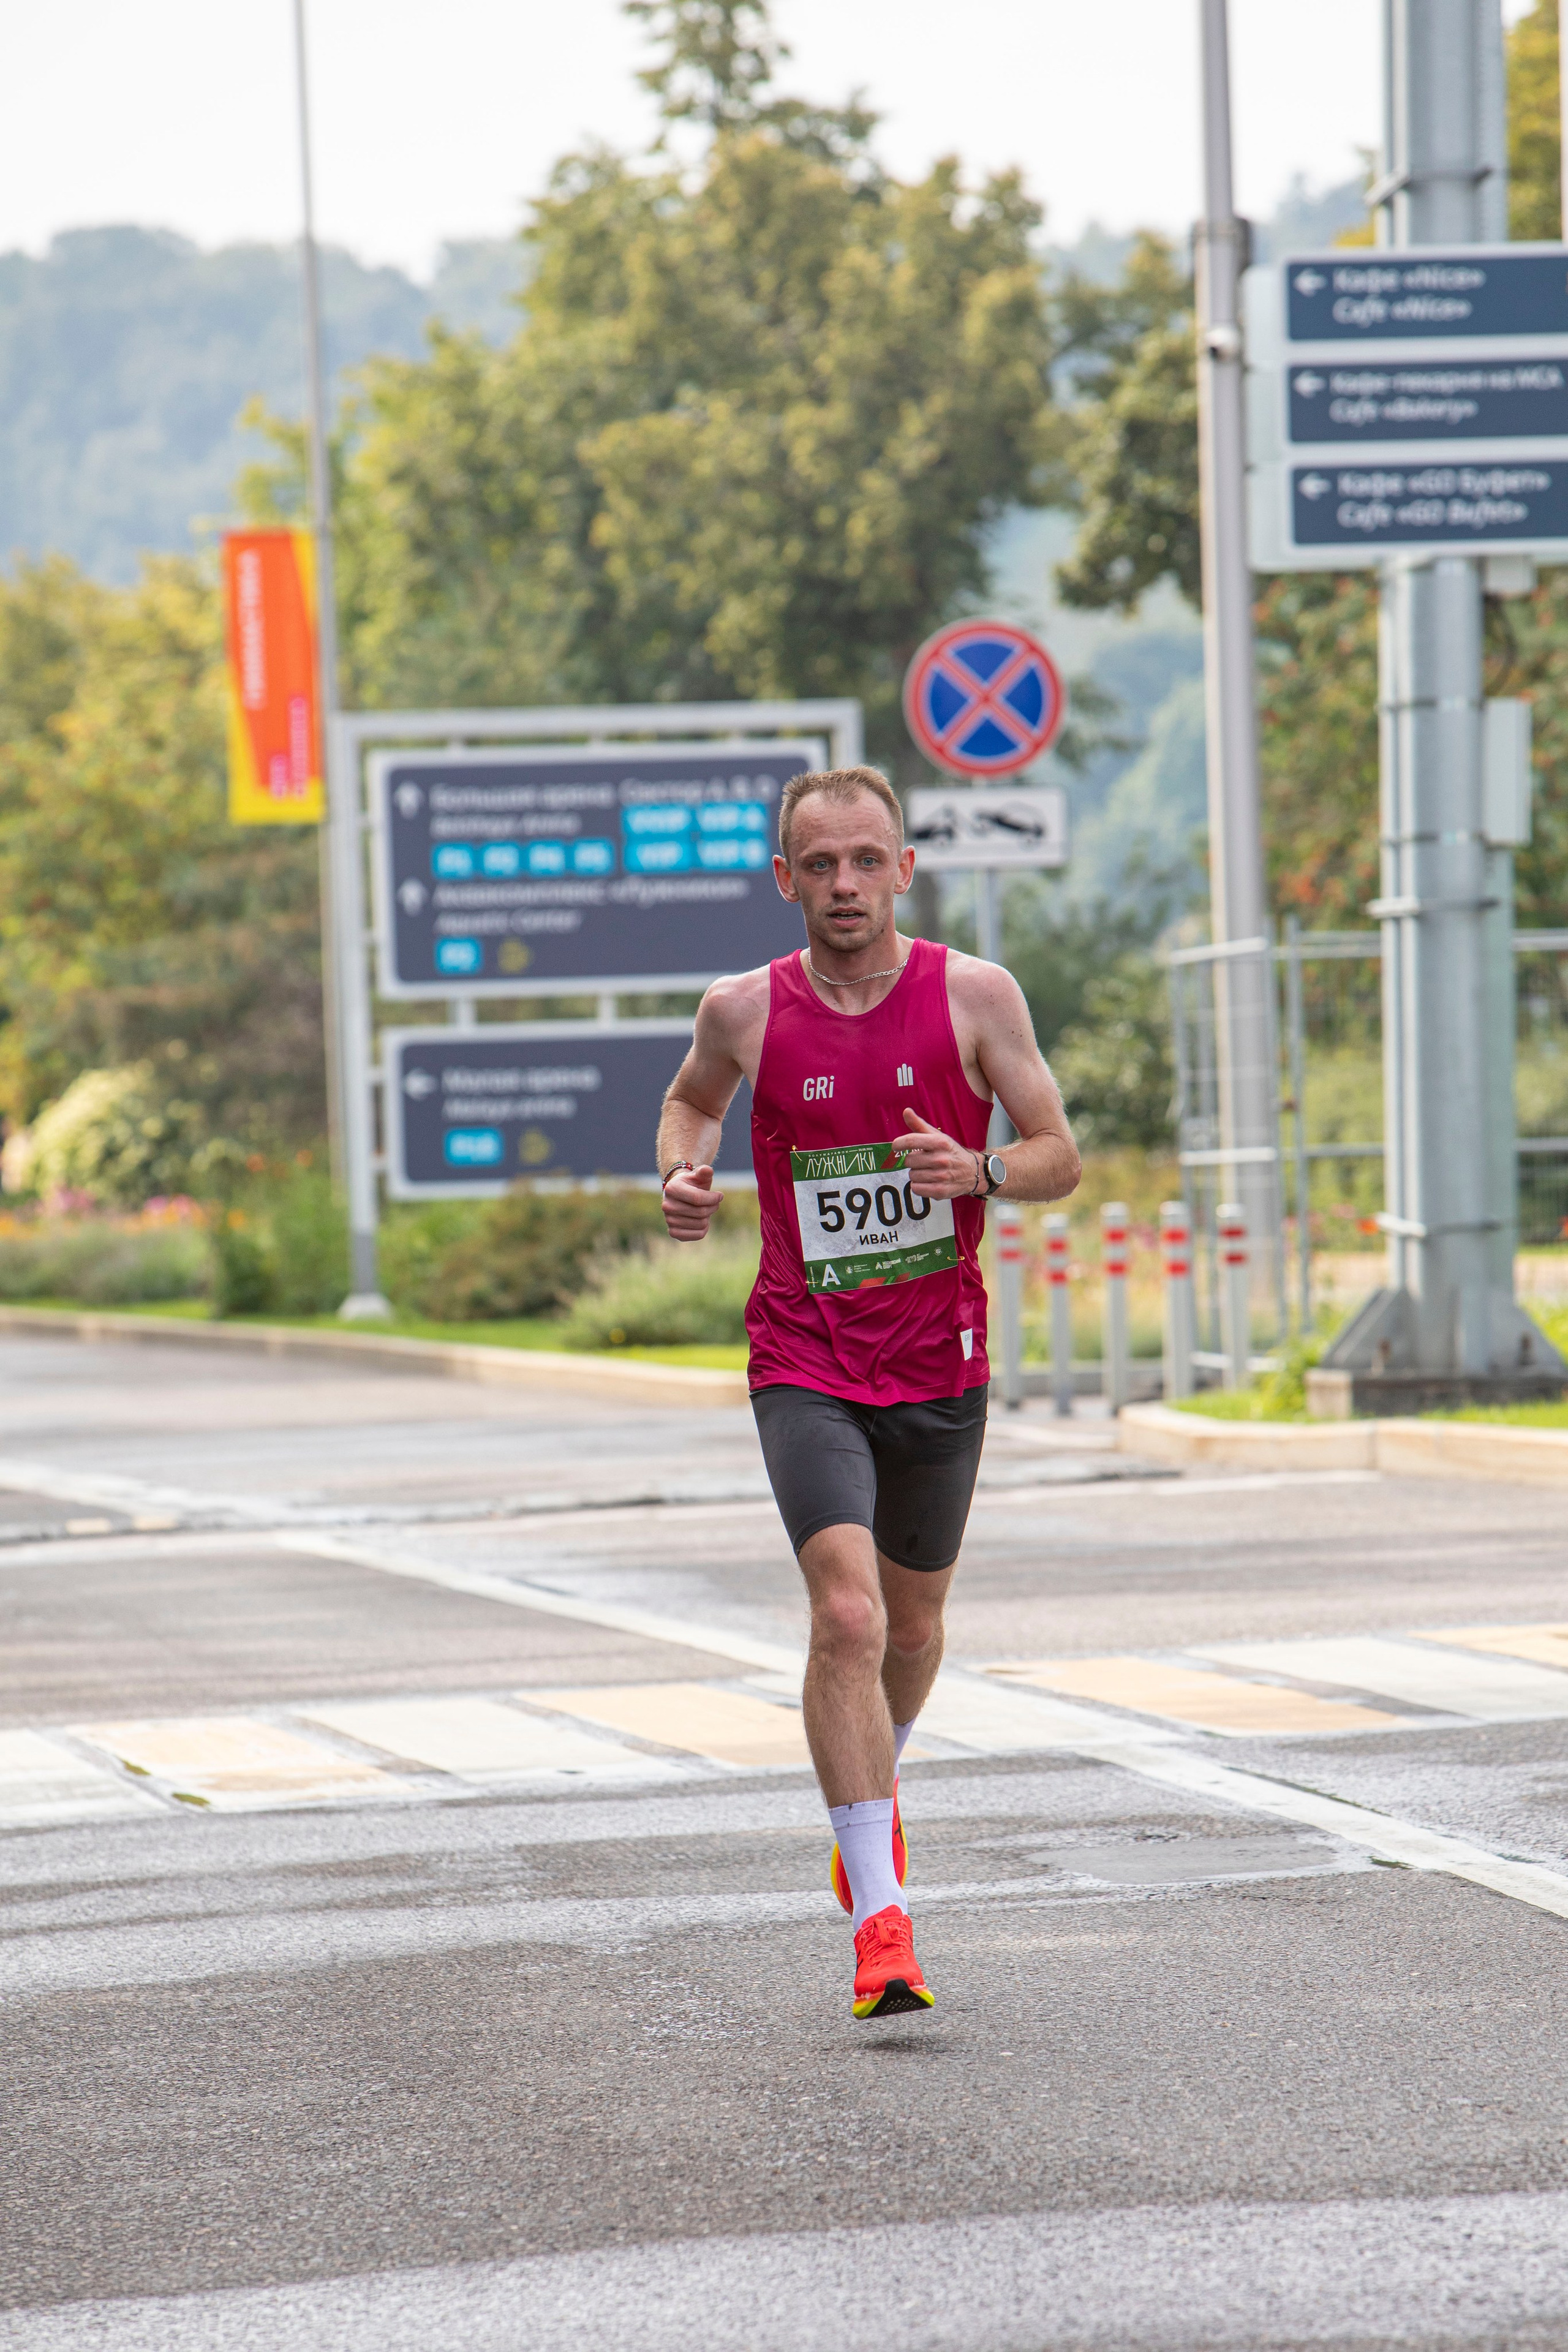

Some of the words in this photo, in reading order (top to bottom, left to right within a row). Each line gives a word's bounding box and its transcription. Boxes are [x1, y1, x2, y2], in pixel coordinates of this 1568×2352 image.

[803, 1075, 835, 1101] GRi
[805, 1152, 876, 1178] ЛУЖНИКИ
[816, 1180, 931, 1234] 5900
[859, 1231, 899, 1246] ИВАН
